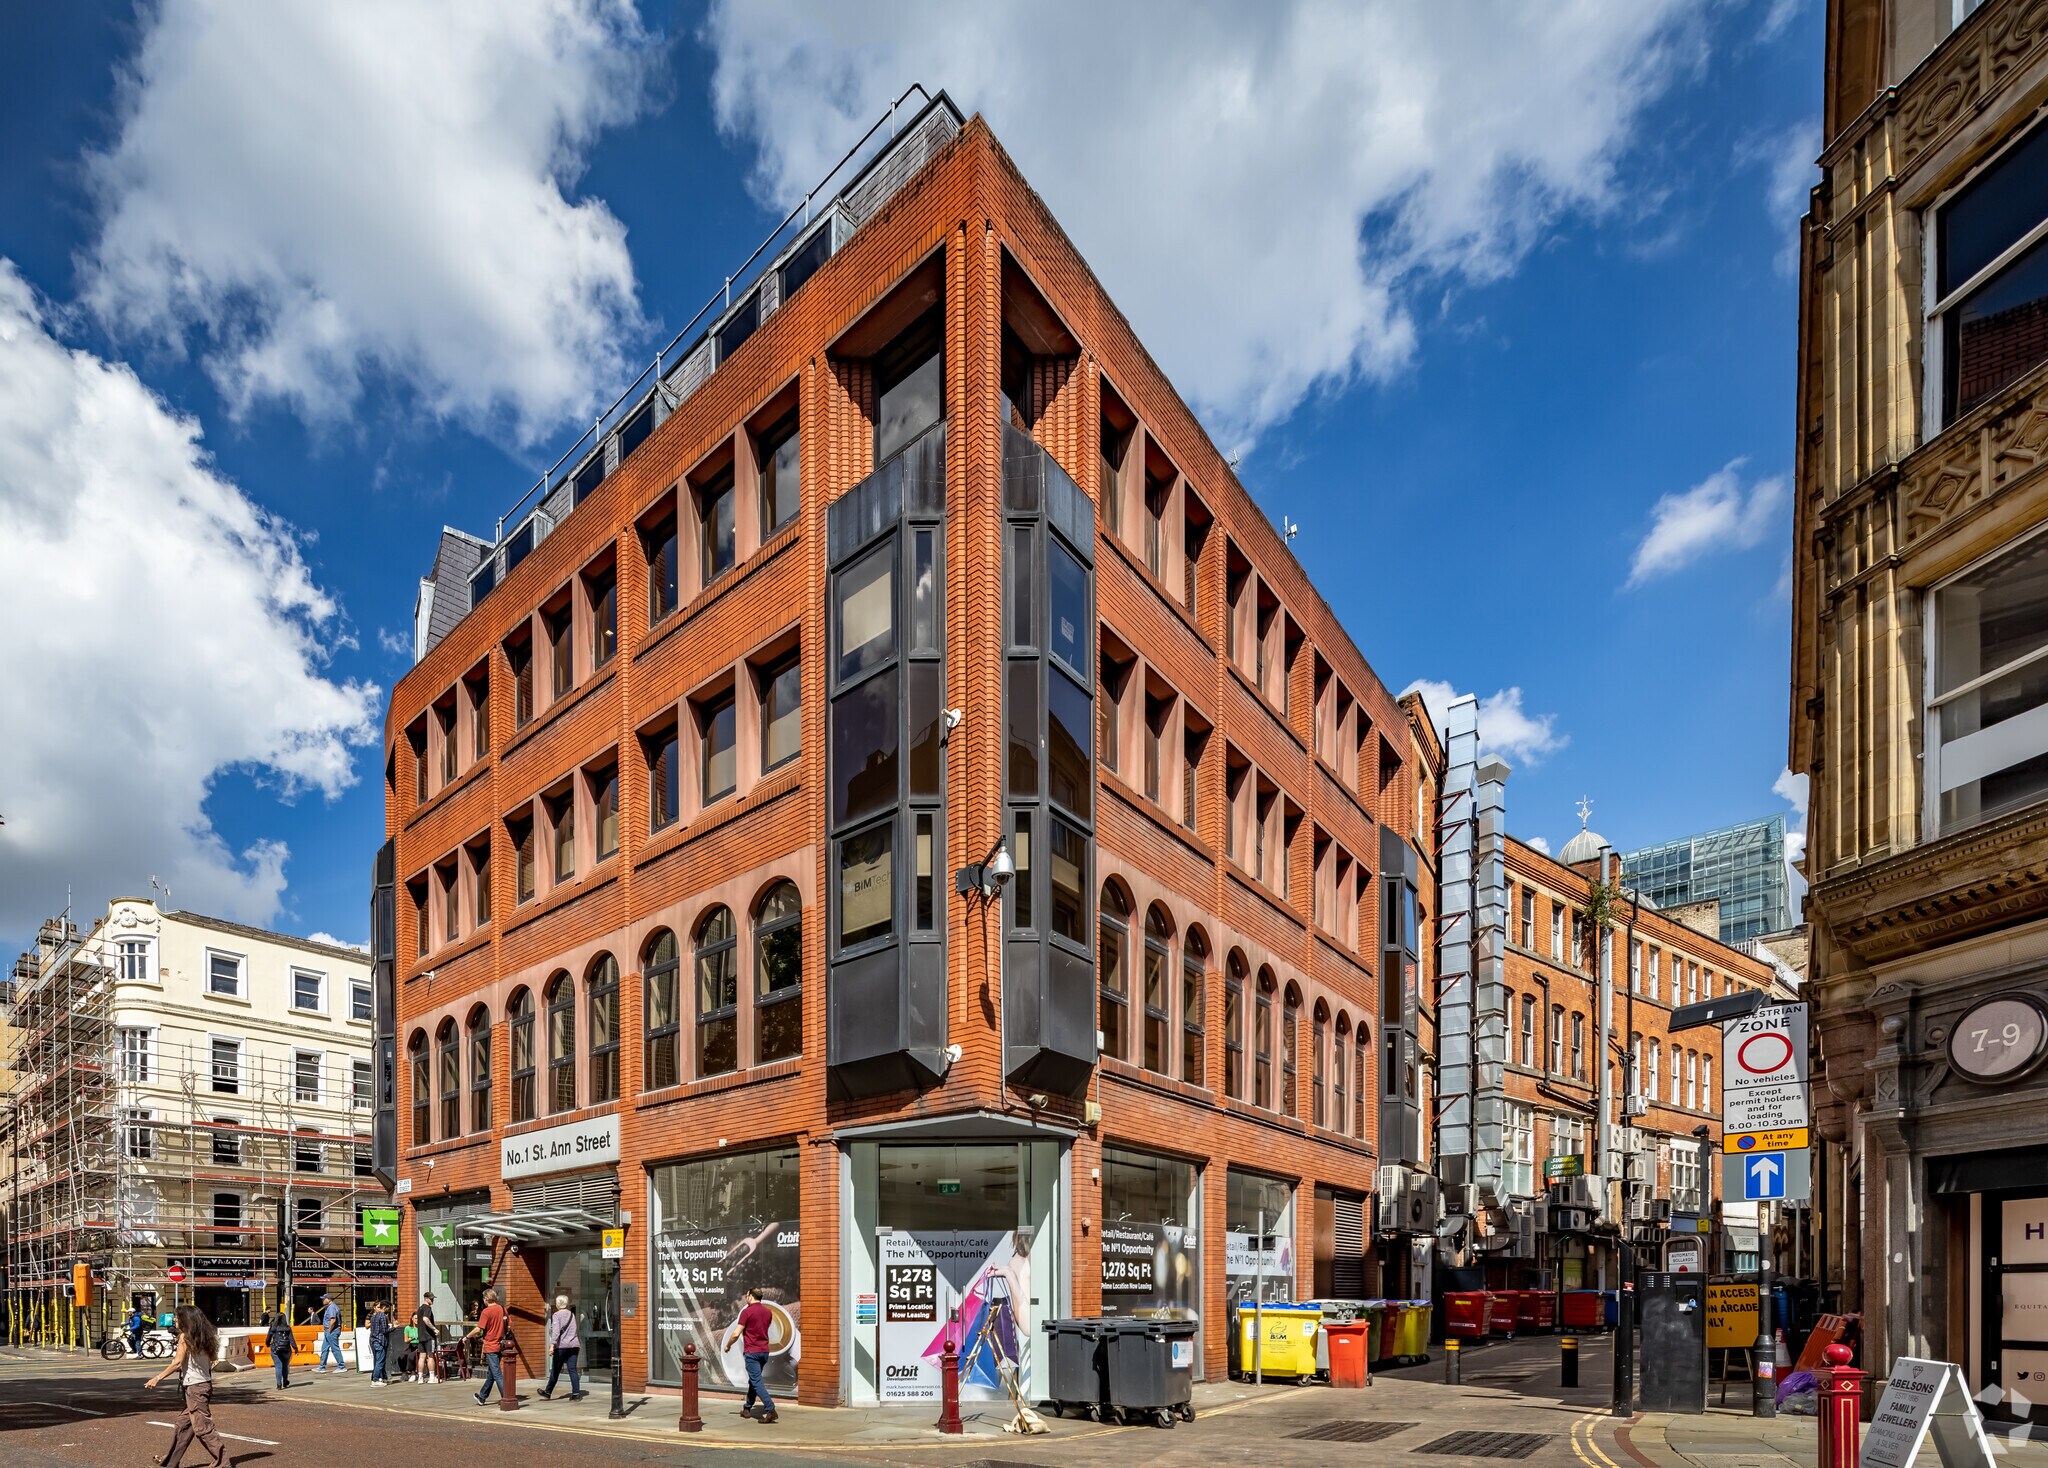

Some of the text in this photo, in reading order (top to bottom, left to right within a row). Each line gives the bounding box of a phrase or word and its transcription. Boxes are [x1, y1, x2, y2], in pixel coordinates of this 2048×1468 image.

[1739, 1016, 1791, 1033] ZONE
[1971, 1023, 2020, 1053] 7-9
[1753, 1074, 1796, 1083] vehicles
[1748, 1088, 1782, 1097] Except
[1729, 1094, 1801, 1107] permit holders
[1747, 1111, 1783, 1120] loading
[506, 1131, 611, 1166] No.1 St. Ann Street
[777, 1231, 799, 1243] Orbit
[886, 1238, 989, 1247] Retail/Restaurant/Café
[657, 1252, 670, 1260] The
[684, 1249, 728, 1261] Opportunity
[886, 1250, 905, 1258] The
[926, 1250, 989, 1260] Opportunity
[1121, 1243, 1154, 1256] Opportunity
[304, 1259, 330, 1269] Italia
[661, 1267, 723, 1284] 1,278 Sq Ft
[889, 1268, 932, 1284] 1,278
[1102, 1262, 1151, 1280] 1,278 Sq Ft
[705, 1286, 725, 1294] Leasing
[889, 1285, 933, 1301] Sq Ft
[1138, 1283, 1152, 1291] Leasing
[1720, 1288, 1756, 1298] ACCESS
[1720, 1303, 1759, 1313] ARCADE
[886, 1365, 919, 1377] Orbit
[1890, 1378, 1935, 1393] ABELSONS
[1890, 1402, 1916, 1415] FAMILY
[1878, 1413, 1918, 1429] JEWELLERS
[1896, 1433, 1913, 1443] GOLD
